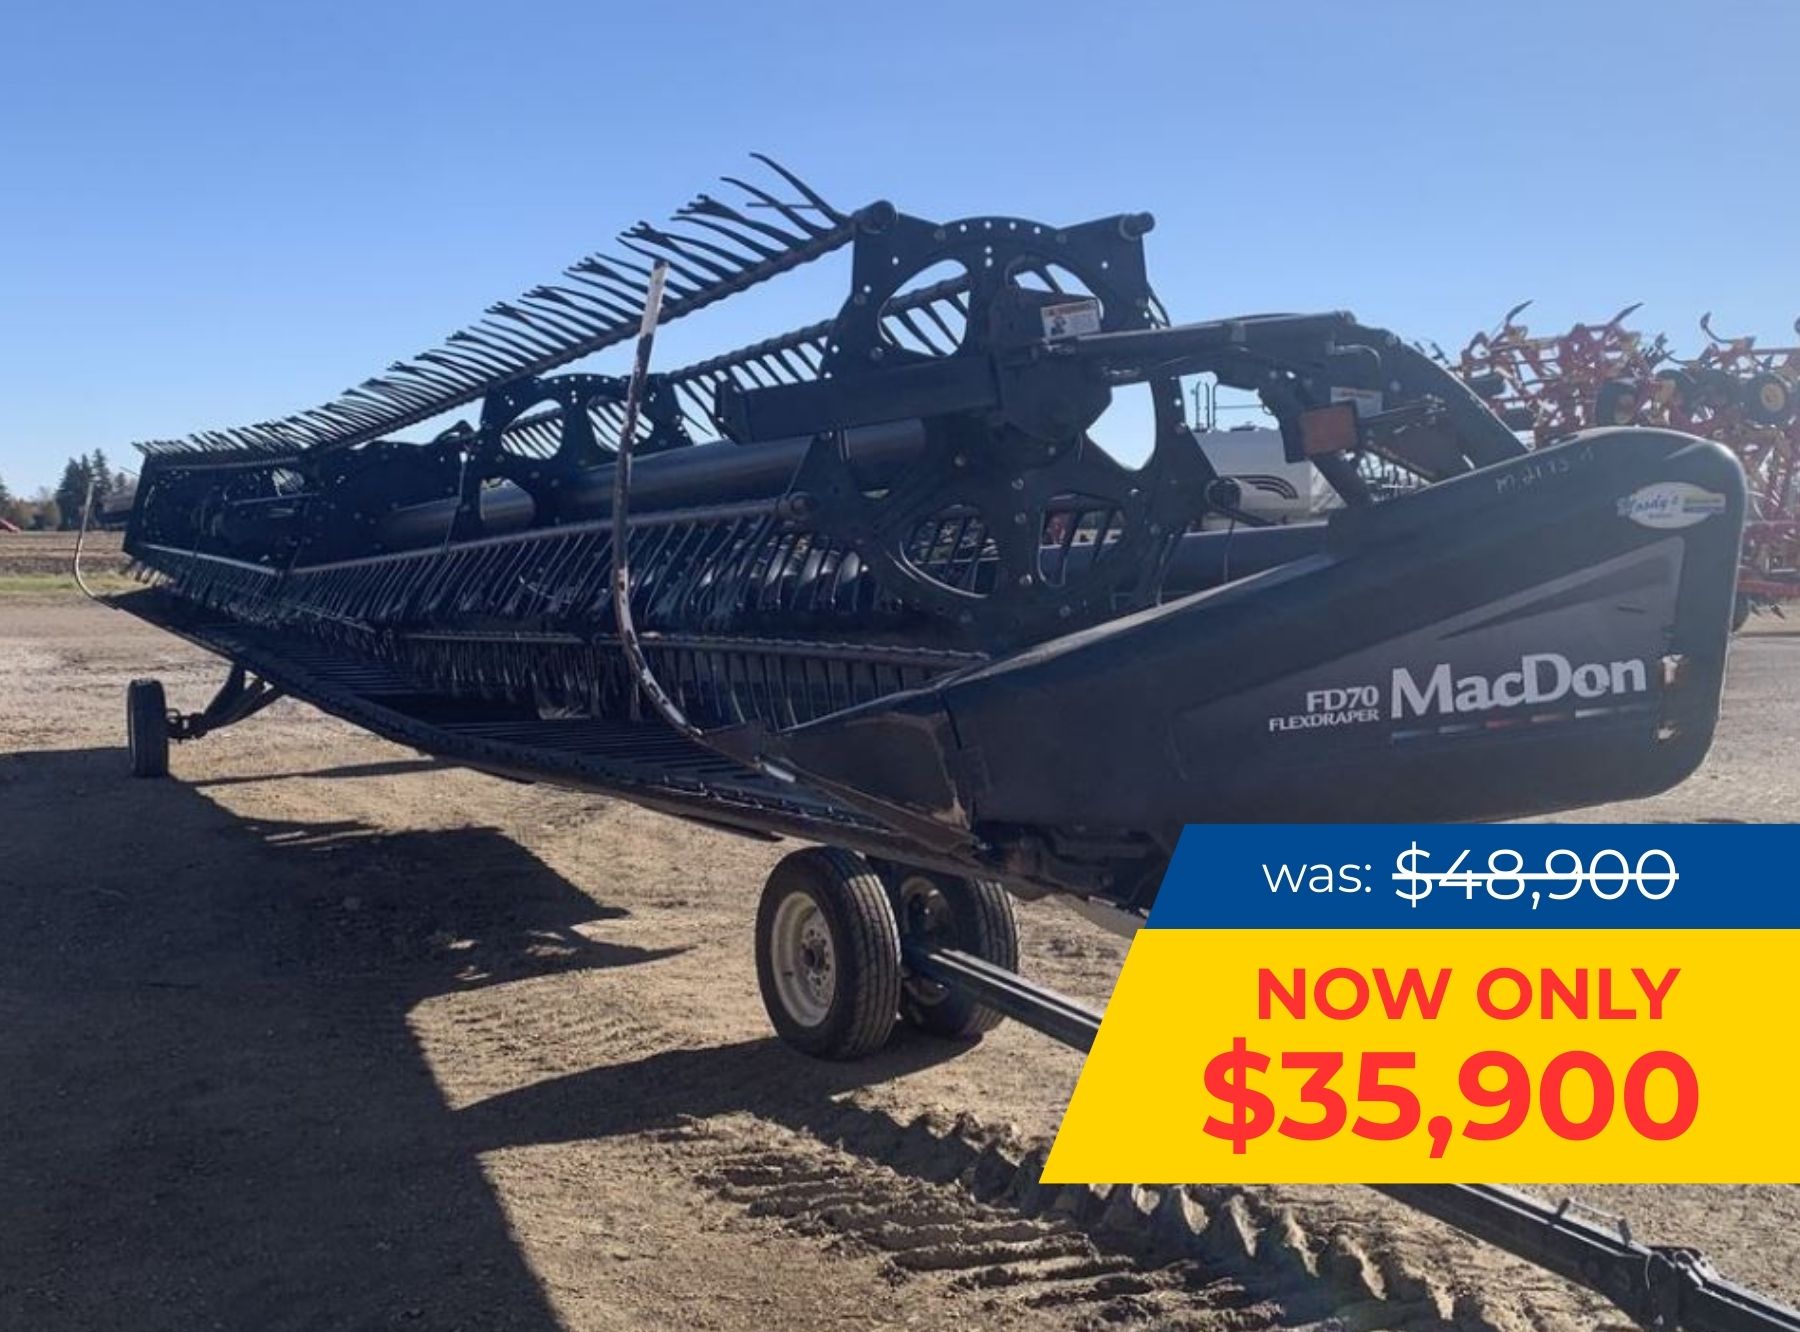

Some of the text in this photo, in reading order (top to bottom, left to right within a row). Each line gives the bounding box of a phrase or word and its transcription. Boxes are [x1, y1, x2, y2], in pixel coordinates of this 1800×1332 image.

[1307, 686, 1379, 712] FD70
[1391, 653, 1647, 719] MacDon
[1269, 708, 1379, 732] FLEXDRAPER
